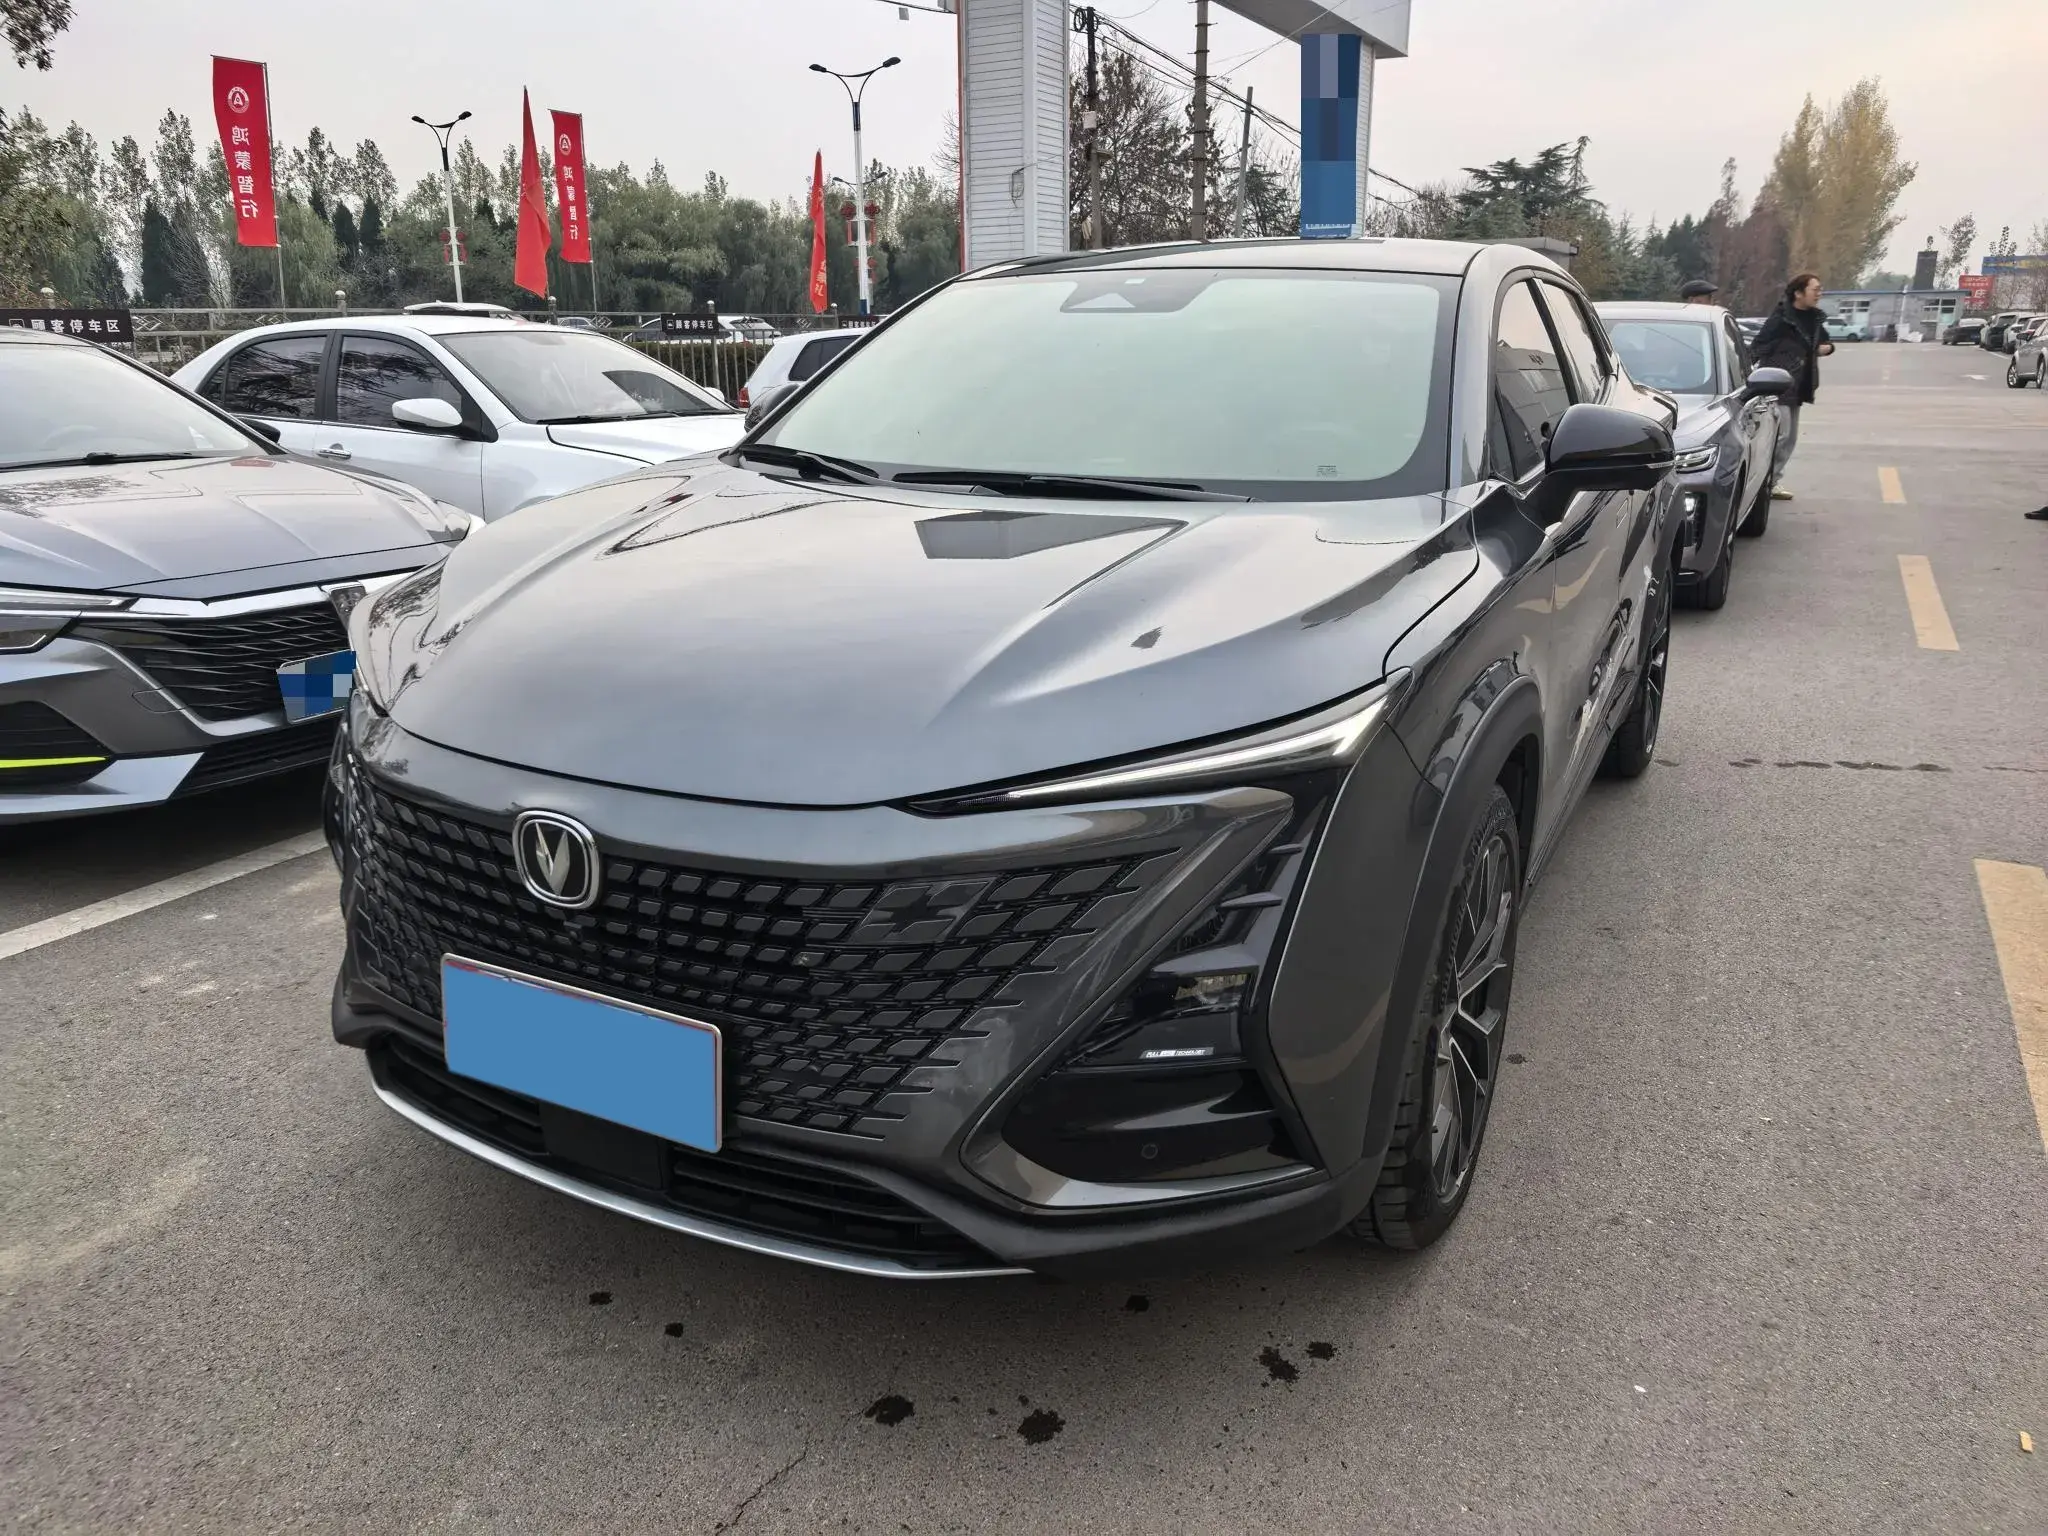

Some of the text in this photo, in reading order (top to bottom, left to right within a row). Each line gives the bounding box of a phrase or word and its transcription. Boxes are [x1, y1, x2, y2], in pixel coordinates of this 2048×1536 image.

[31, 319, 120, 333] 顾客停车区
